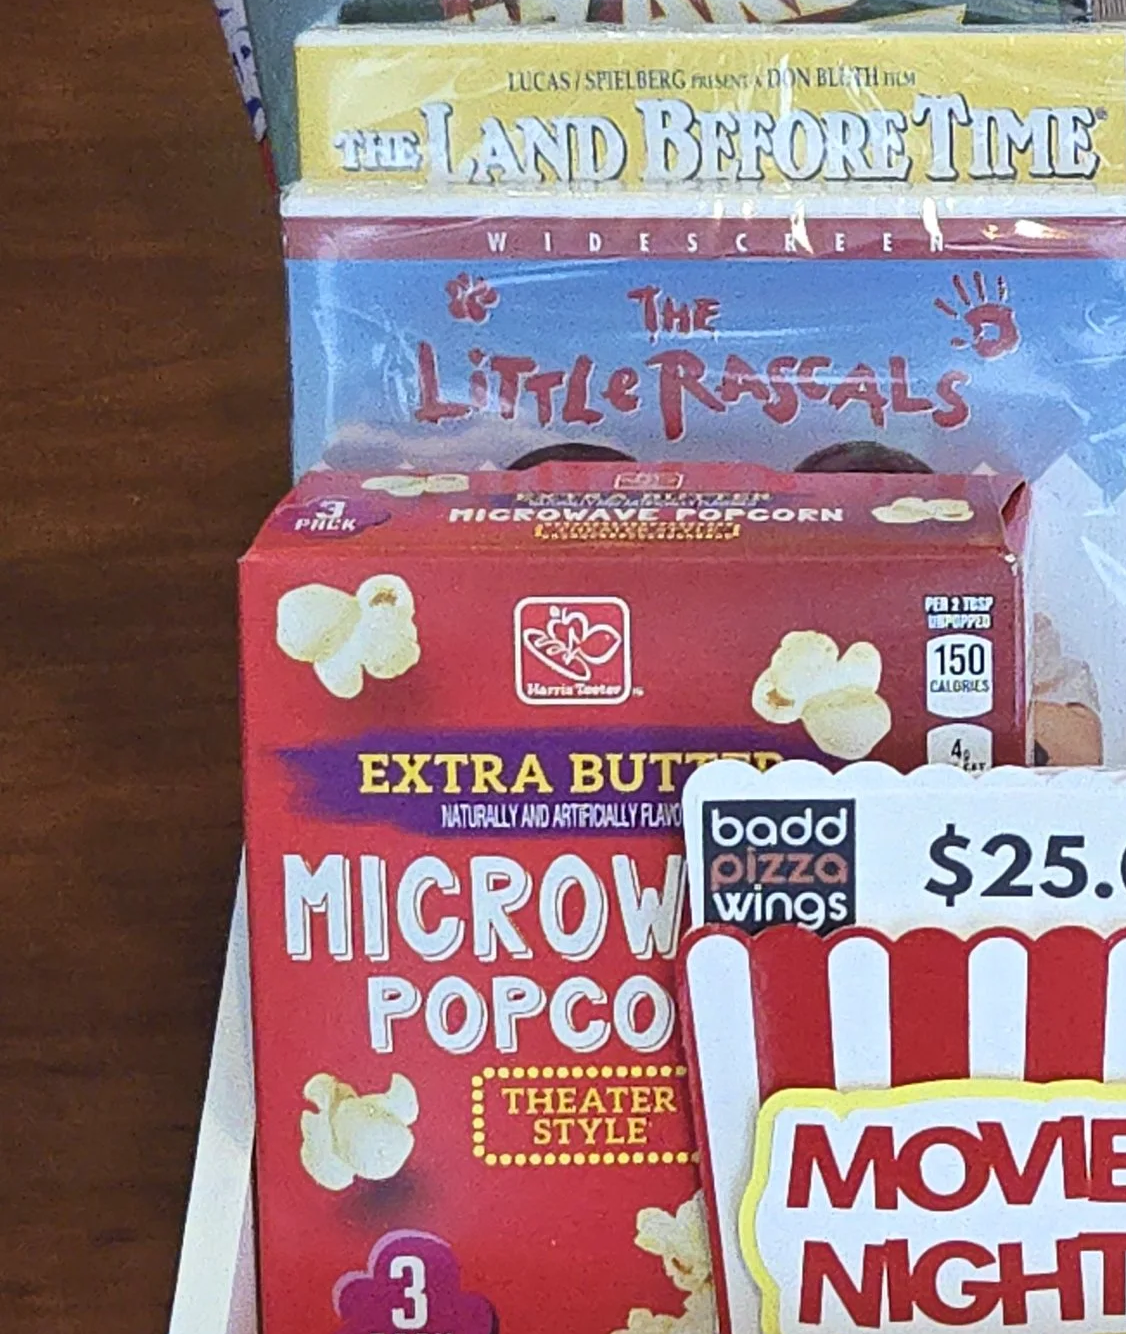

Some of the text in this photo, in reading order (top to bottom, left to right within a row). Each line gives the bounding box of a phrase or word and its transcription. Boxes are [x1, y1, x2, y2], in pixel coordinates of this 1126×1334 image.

[507, 69, 570, 92] LUCAS
[584, 68, 687, 91] SPIELBERG
[767, 67, 811, 88] DON
[334, 92, 1101, 184] THE LAND BEFORE TIME
[487, 230, 945, 254] WIDESCREEN
[628, 284, 721, 341] THE
[644, 348, 972, 442] RASCALS
[294, 517, 357, 532] PACK
[315, 500, 347, 519] 3
[449, 507, 844, 523] MICROWAVE POPCORN
[925, 596, 949, 612] PER
[951, 597, 960, 612] 2
[934, 643, 985, 676] 150
[930, 679, 990, 693] CALORIES
[358, 752, 785, 795] EXTRA BUT
[441, 803, 520, 828] NATURALLY
[522, 803, 549, 828] AND
[553, 802, 637, 828] ARTIFICIALLY
[711, 808, 848, 848] badd
[710, 846, 848, 892] pizza
[711, 883, 848, 930] wings
[368, 974, 677, 1055] POPCO
[501, 1084, 679, 1117] THEATER
[531, 1114, 651, 1147] STYLE
[390, 1255, 430, 1330] 3
